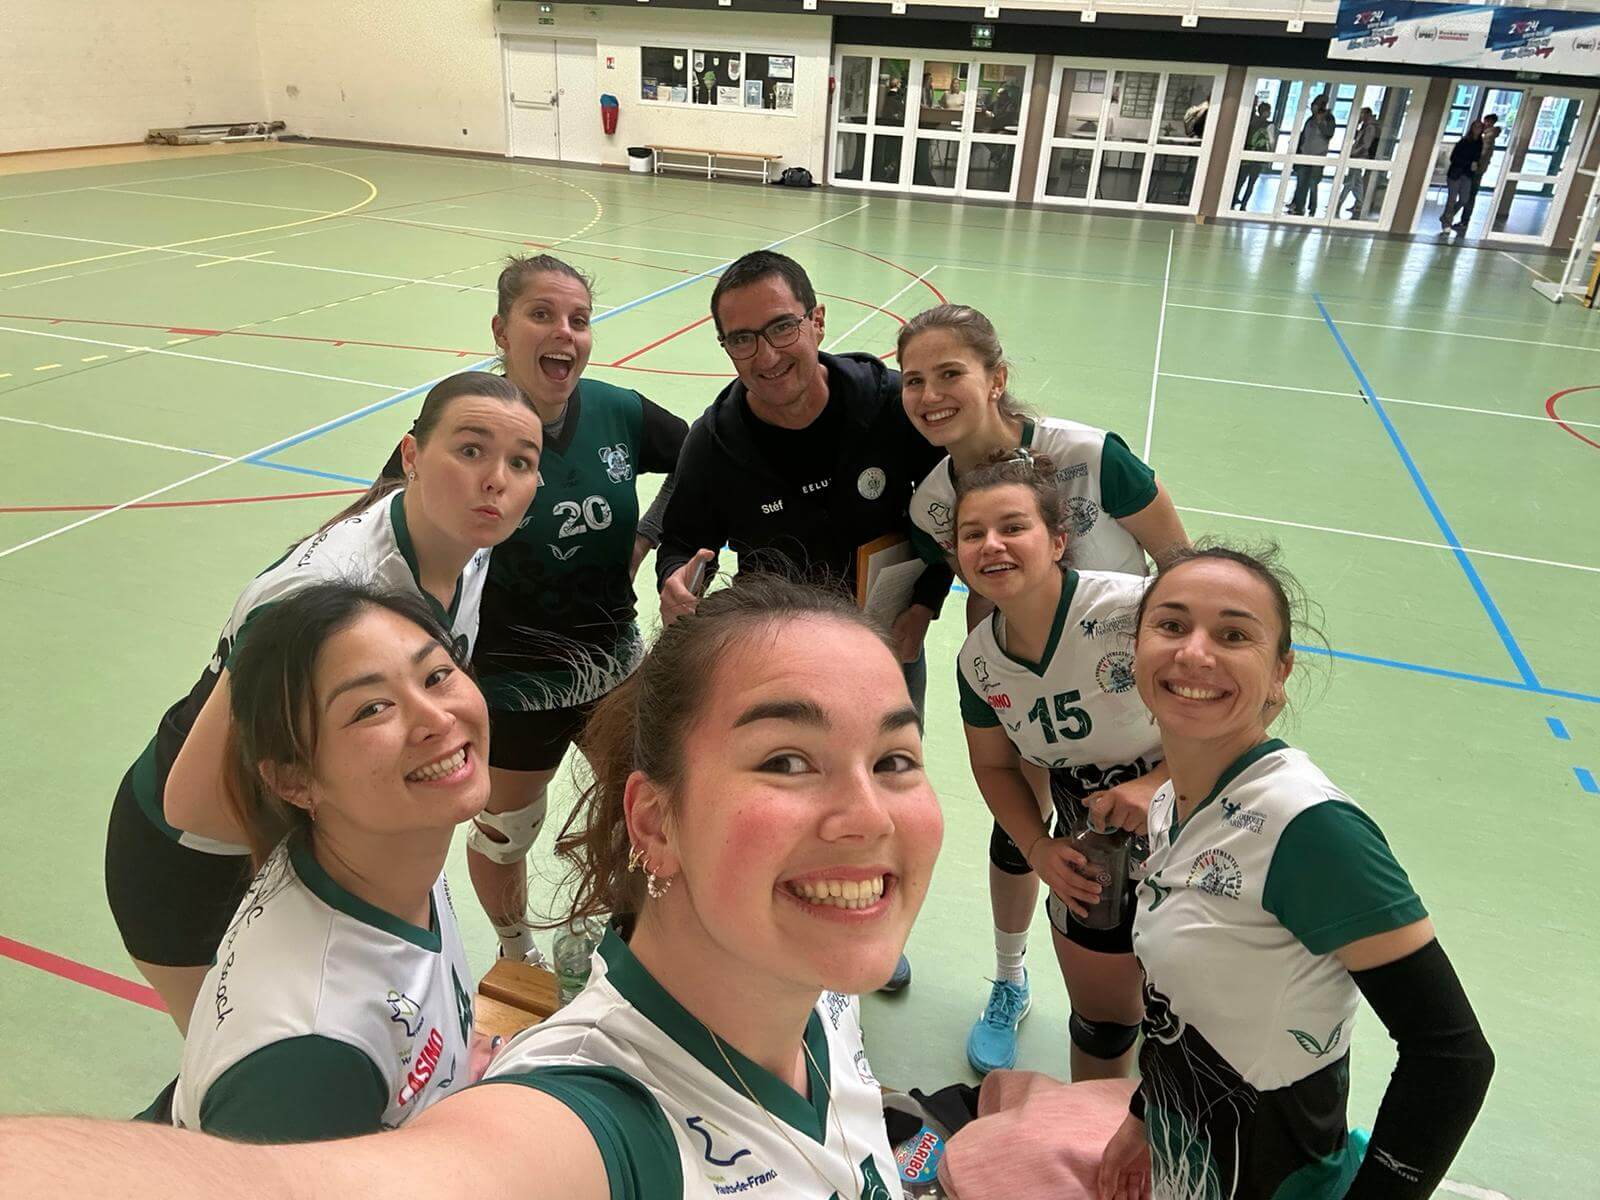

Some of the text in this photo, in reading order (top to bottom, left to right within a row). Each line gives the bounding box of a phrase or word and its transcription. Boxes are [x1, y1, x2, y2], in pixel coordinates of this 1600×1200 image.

[553, 495, 613, 539] 20
[761, 499, 783, 514] Stéf
[1028, 690, 1092, 744] 15
[904, 1132, 938, 1179] HARIBO
